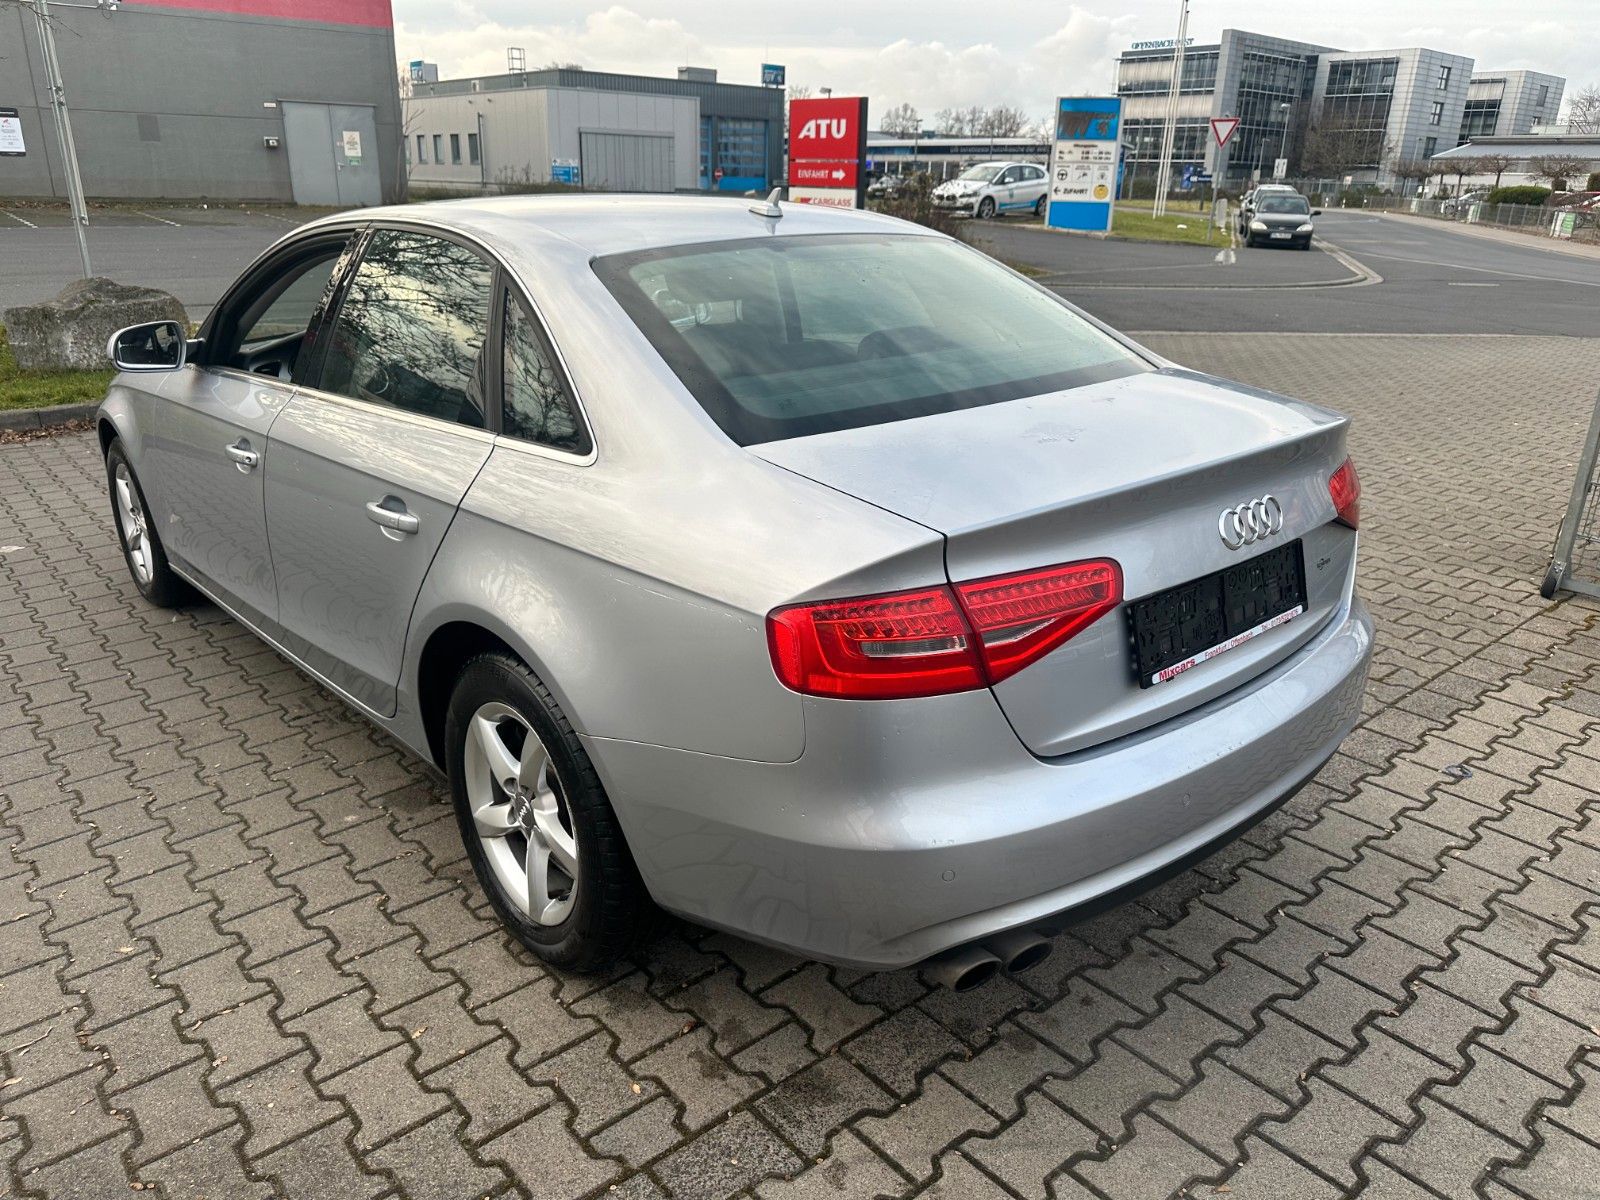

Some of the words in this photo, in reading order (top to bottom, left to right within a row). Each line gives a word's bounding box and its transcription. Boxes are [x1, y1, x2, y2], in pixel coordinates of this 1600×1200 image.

[798, 118, 847, 139] ATU
[798, 168, 829, 179] EINFAHRT
[1062, 186, 1089, 195] ZUFAHRT
[813, 196, 853, 207] CARGLASS
[1159, 658, 1196, 681] Mixcars
